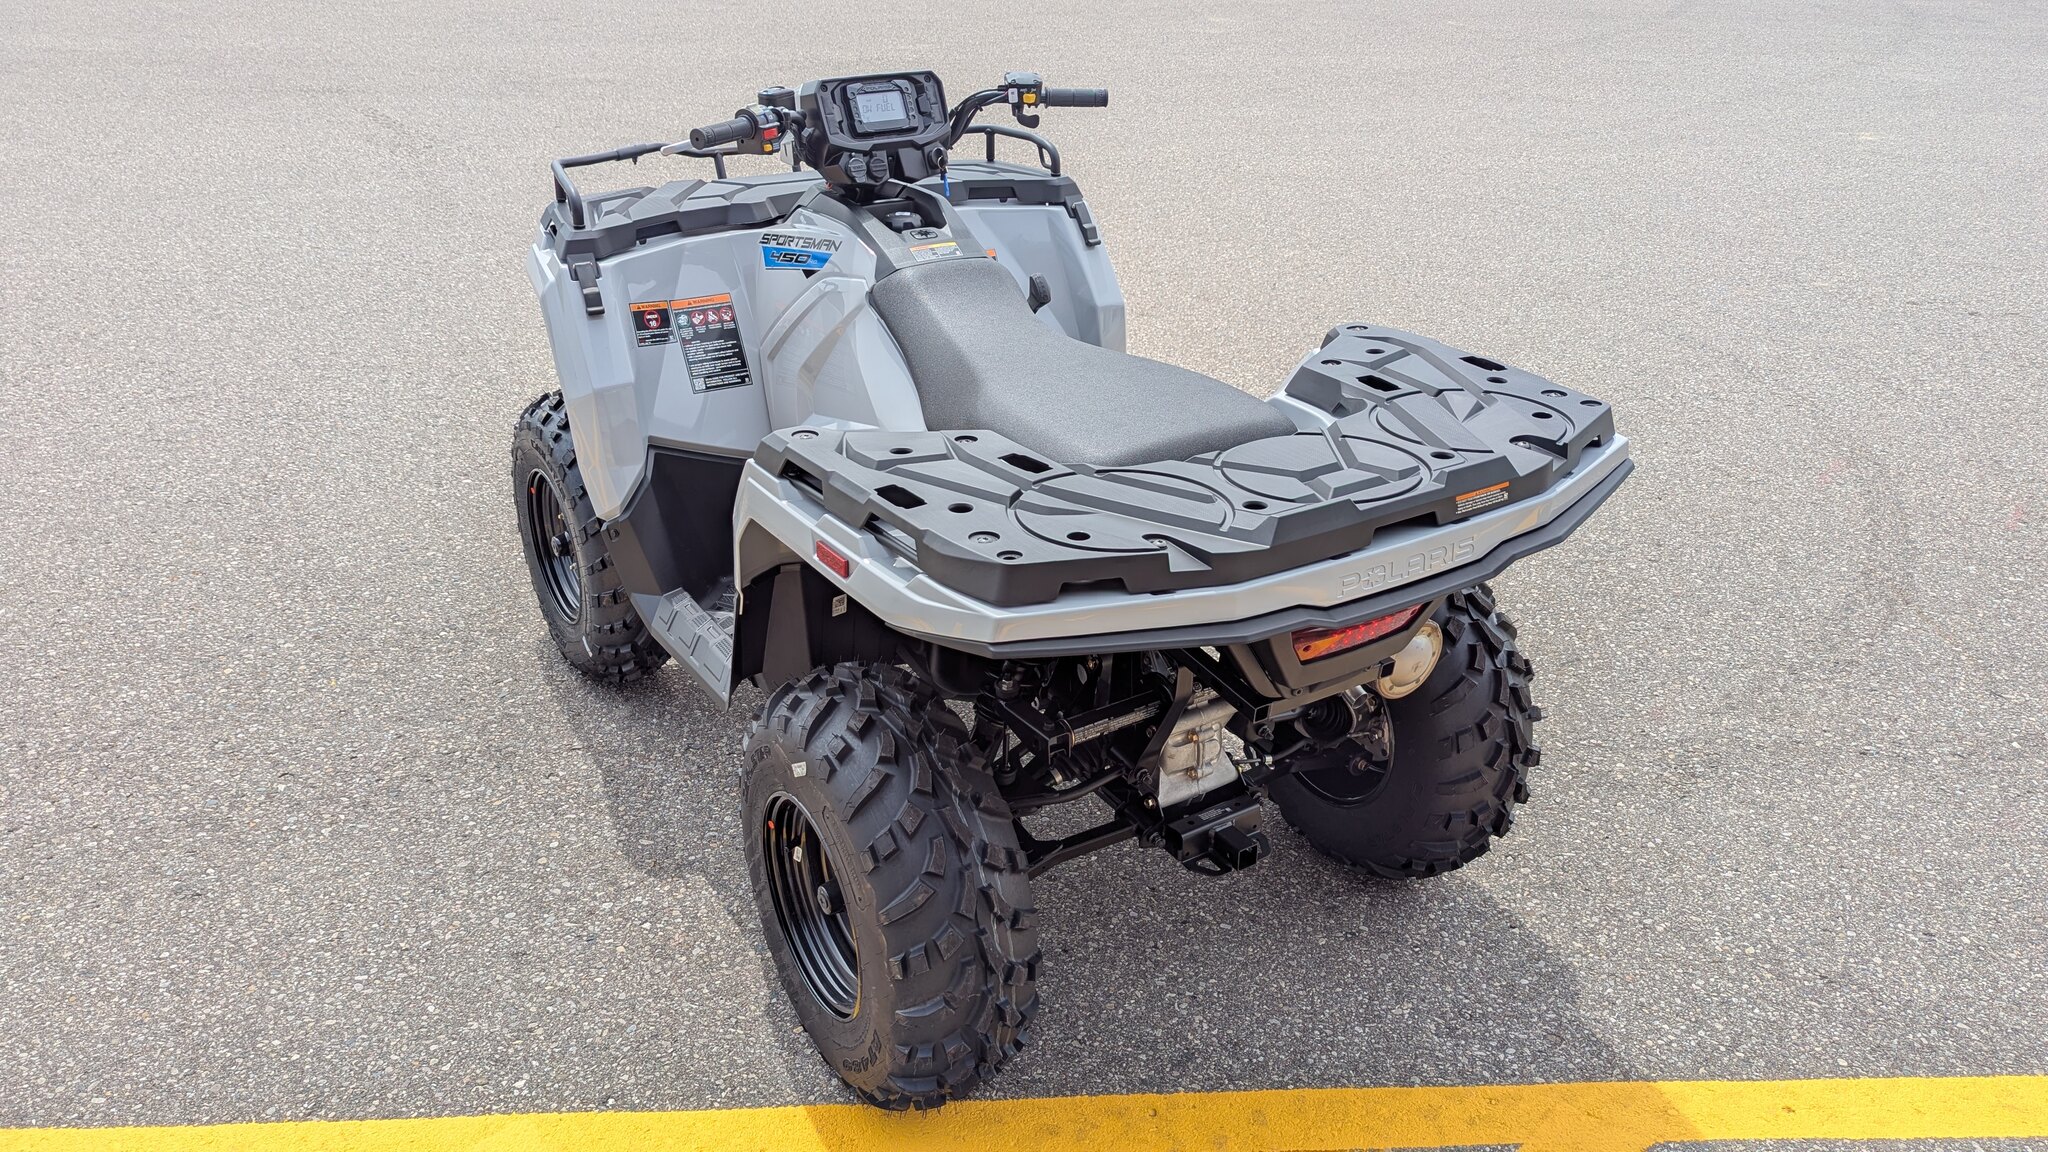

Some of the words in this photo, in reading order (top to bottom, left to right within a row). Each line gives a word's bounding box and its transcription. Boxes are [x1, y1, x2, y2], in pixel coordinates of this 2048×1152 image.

[876, 103, 896, 113] FUEL
[759, 233, 843, 252] SPORTSMAN
[770, 251, 811, 264] 450
[1337, 535, 1477, 598] POLARIS
